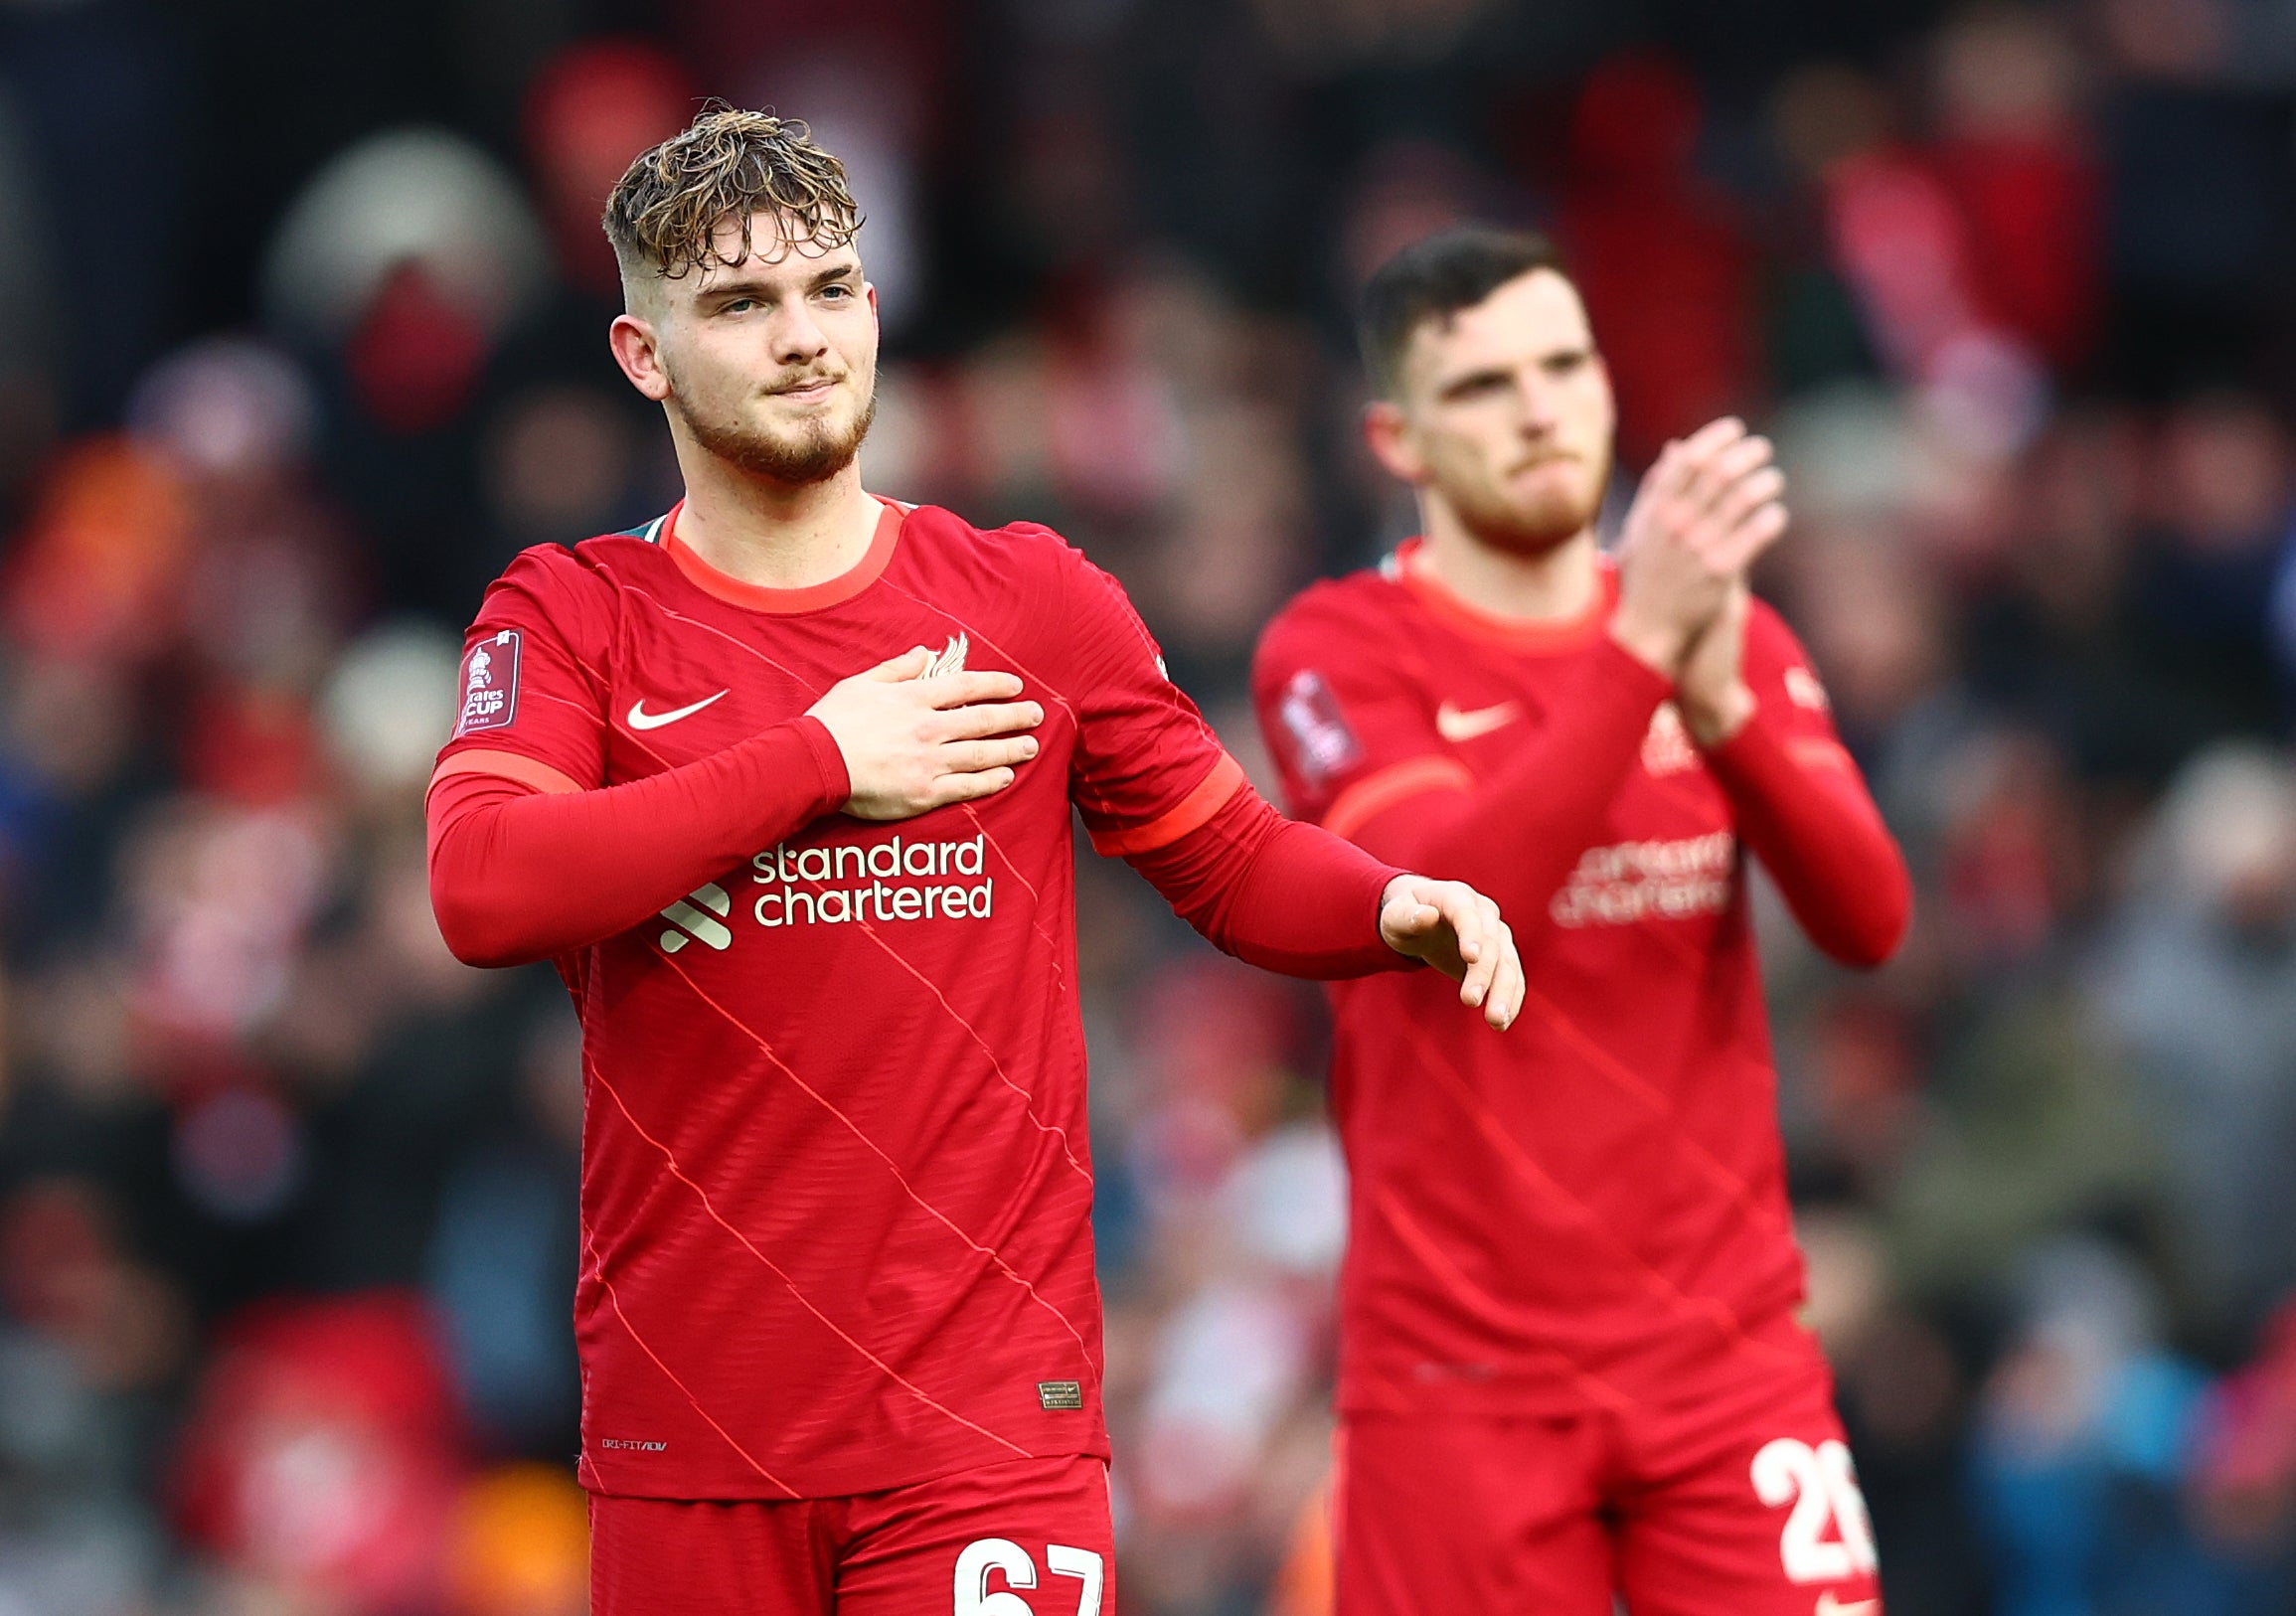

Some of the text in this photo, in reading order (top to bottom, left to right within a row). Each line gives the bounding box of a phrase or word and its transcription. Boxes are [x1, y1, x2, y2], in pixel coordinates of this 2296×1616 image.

[466, 701, 504, 717] CUP
[469, 690, 504, 702] rates
[752, 834, 984, 884] standard
[754, 877, 993, 927] chartered
[953, 1537, 1104, 1616] 67
